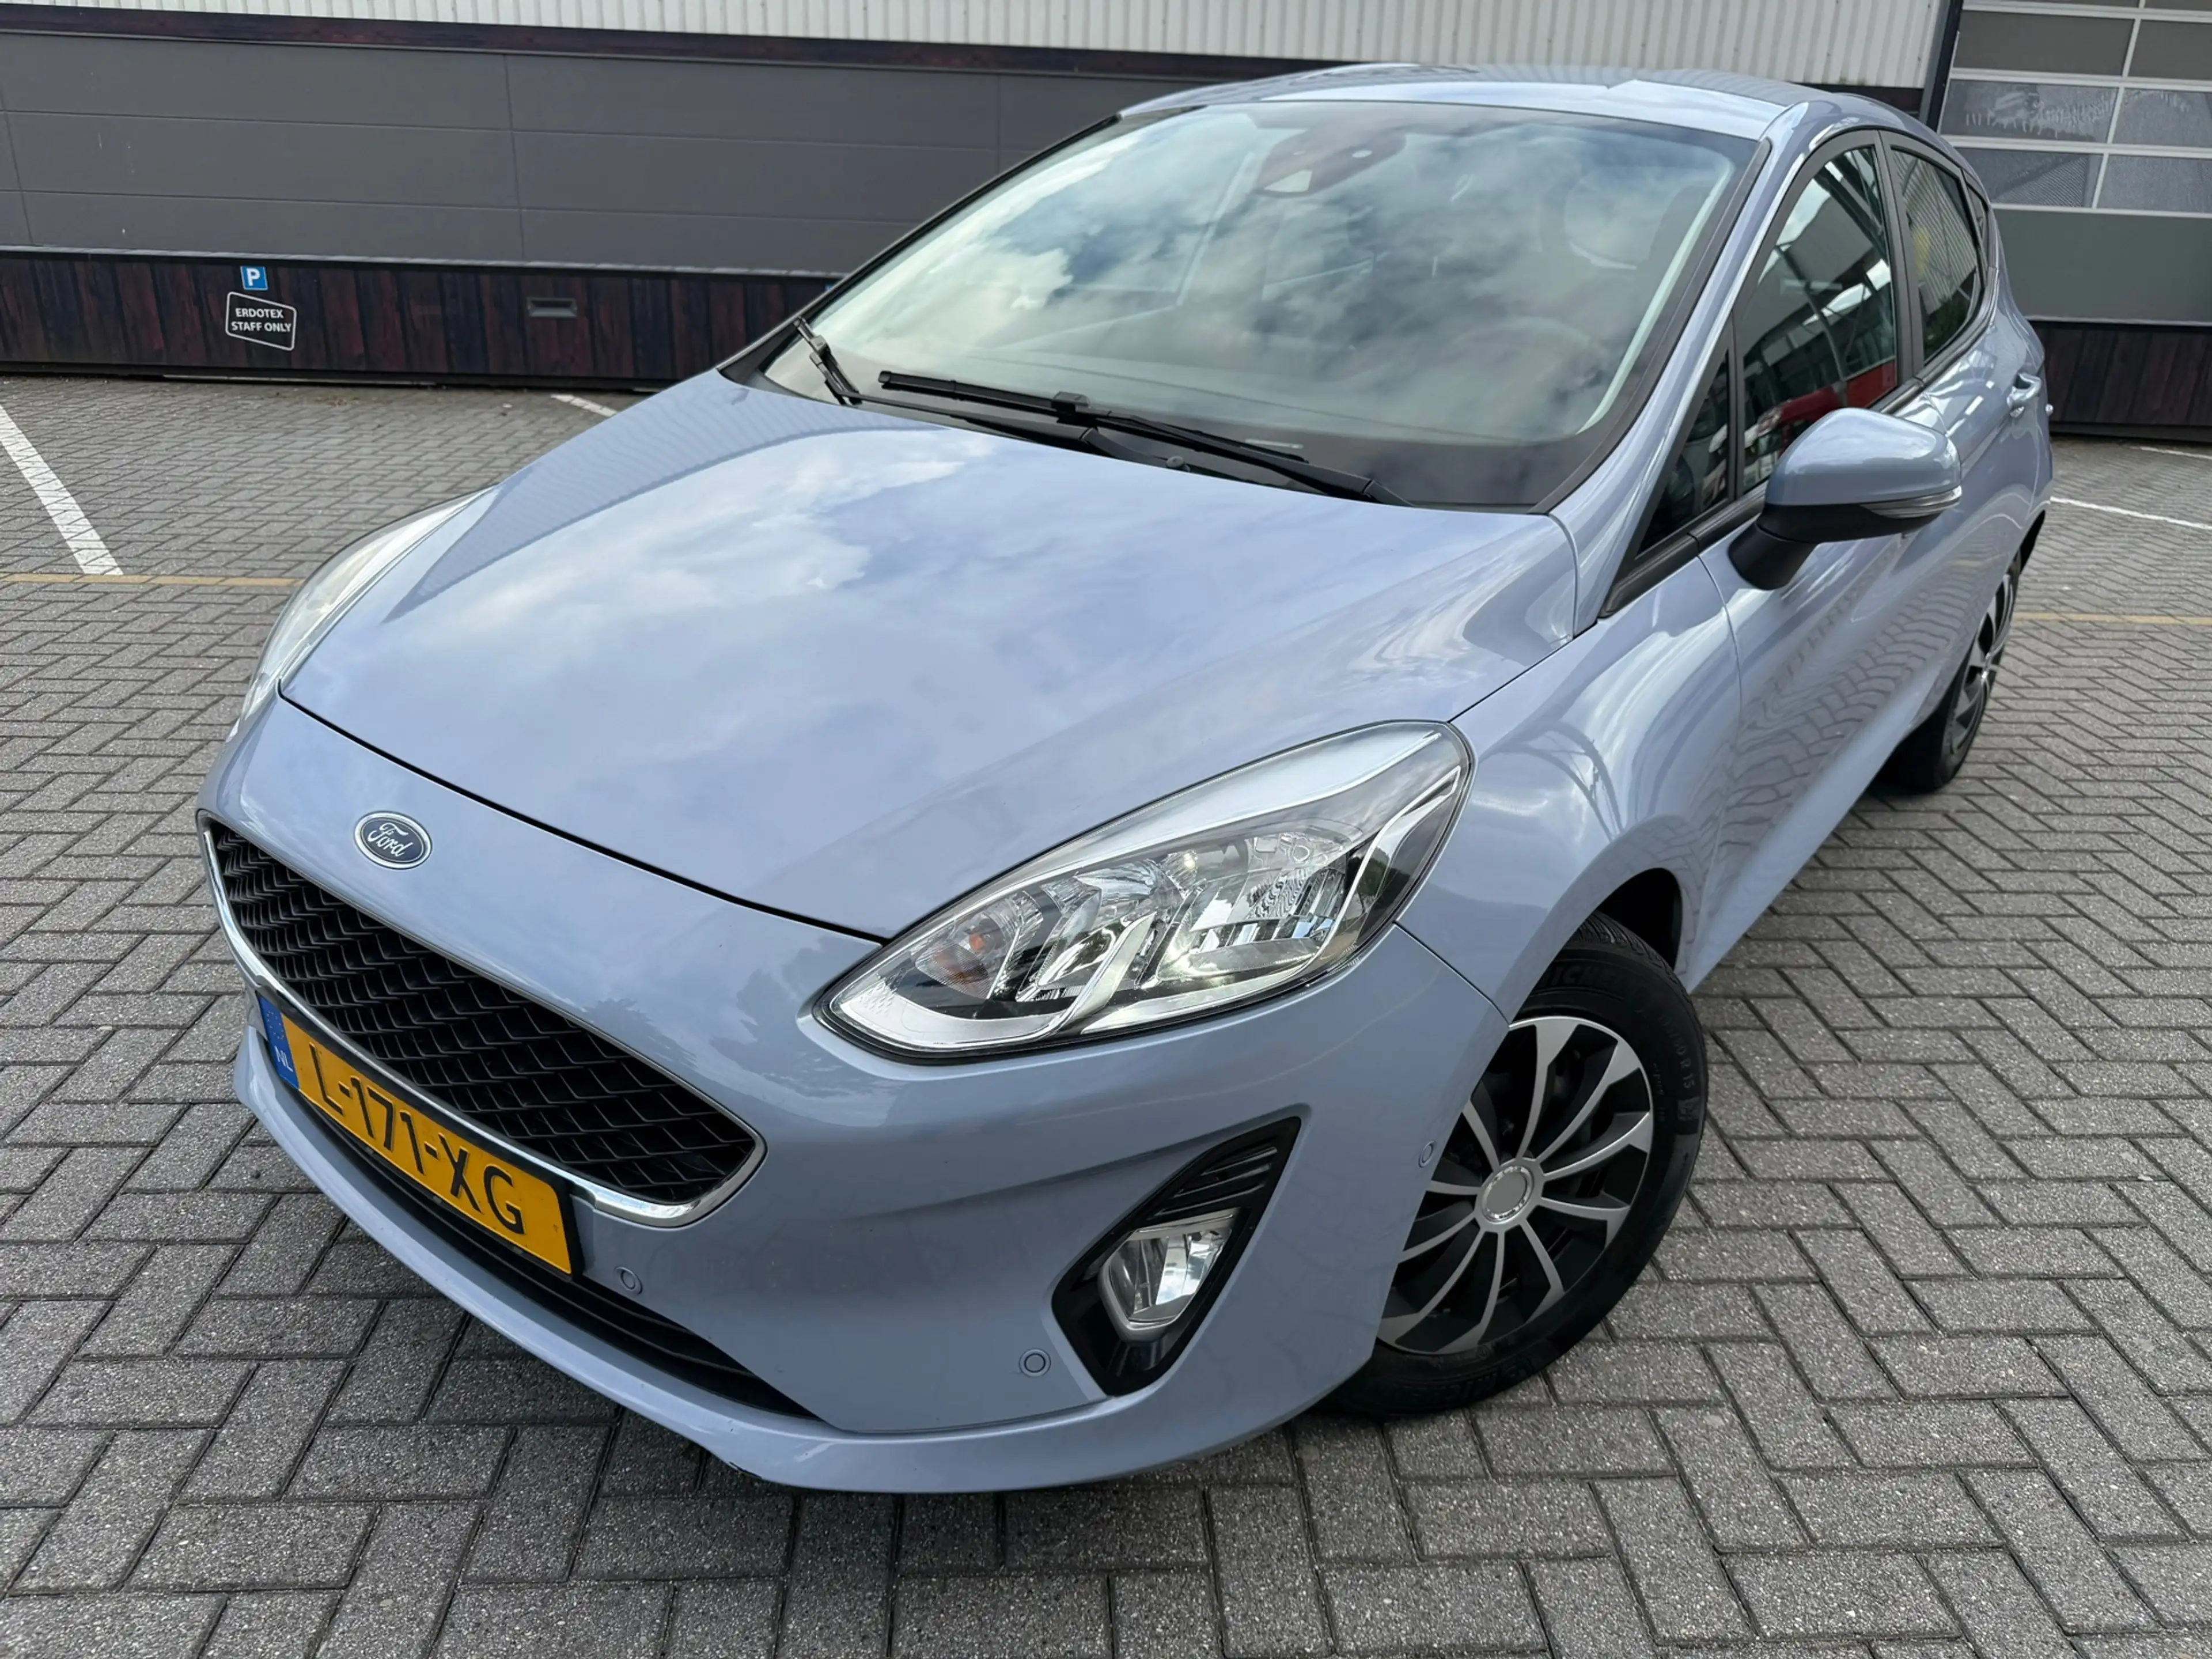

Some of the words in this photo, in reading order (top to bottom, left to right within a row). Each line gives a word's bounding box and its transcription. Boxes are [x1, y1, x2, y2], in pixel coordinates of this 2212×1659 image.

[246, 268, 260, 286] P
[235, 308, 285, 319] ERDOTEX
[231, 321, 262, 331] STAFF
[264, 322, 292, 332] ONLY
[367, 822, 414, 857] Ford
[274, 1045, 294, 1072] NL
[1680, 1058, 1692, 1069] R
[1683, 1073, 1695, 1089] 15
[309, 1042, 525, 1235] L-171-XG
